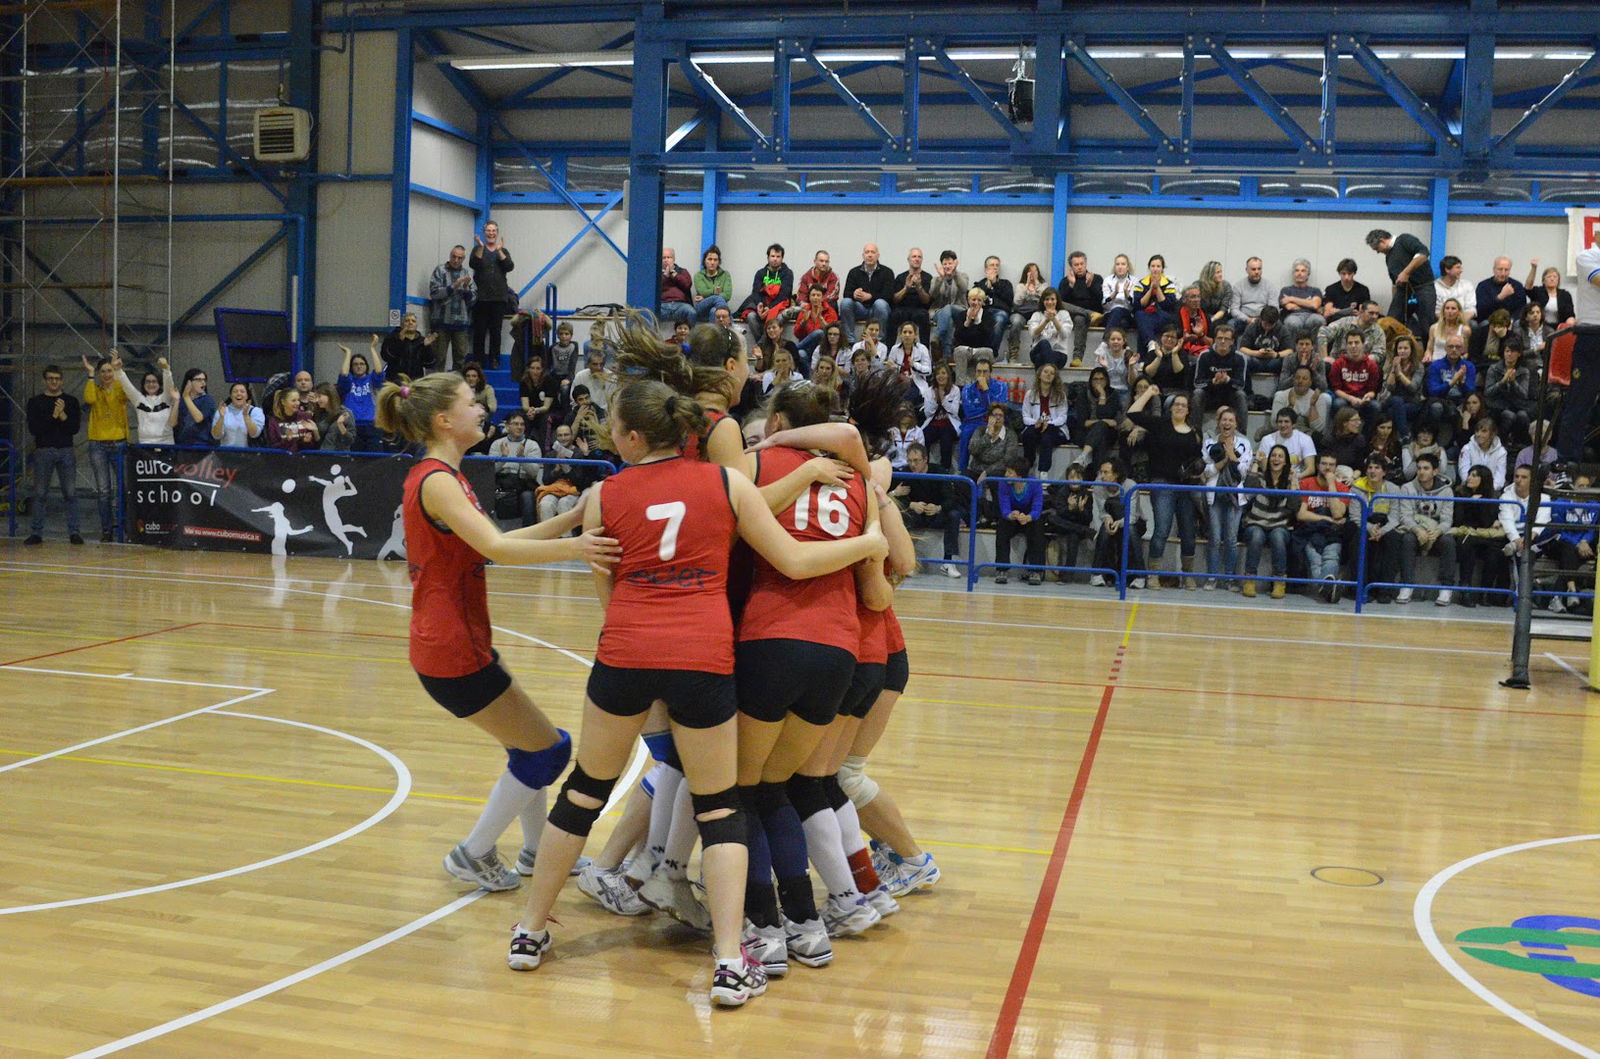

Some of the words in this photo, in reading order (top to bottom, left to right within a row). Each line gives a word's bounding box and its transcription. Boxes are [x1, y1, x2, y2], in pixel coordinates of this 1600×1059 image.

[136, 460, 172, 475] euro
[174, 460, 237, 488] volley
[137, 485, 217, 507] school
[795, 485, 850, 537] 16
[645, 501, 686, 561] 7
